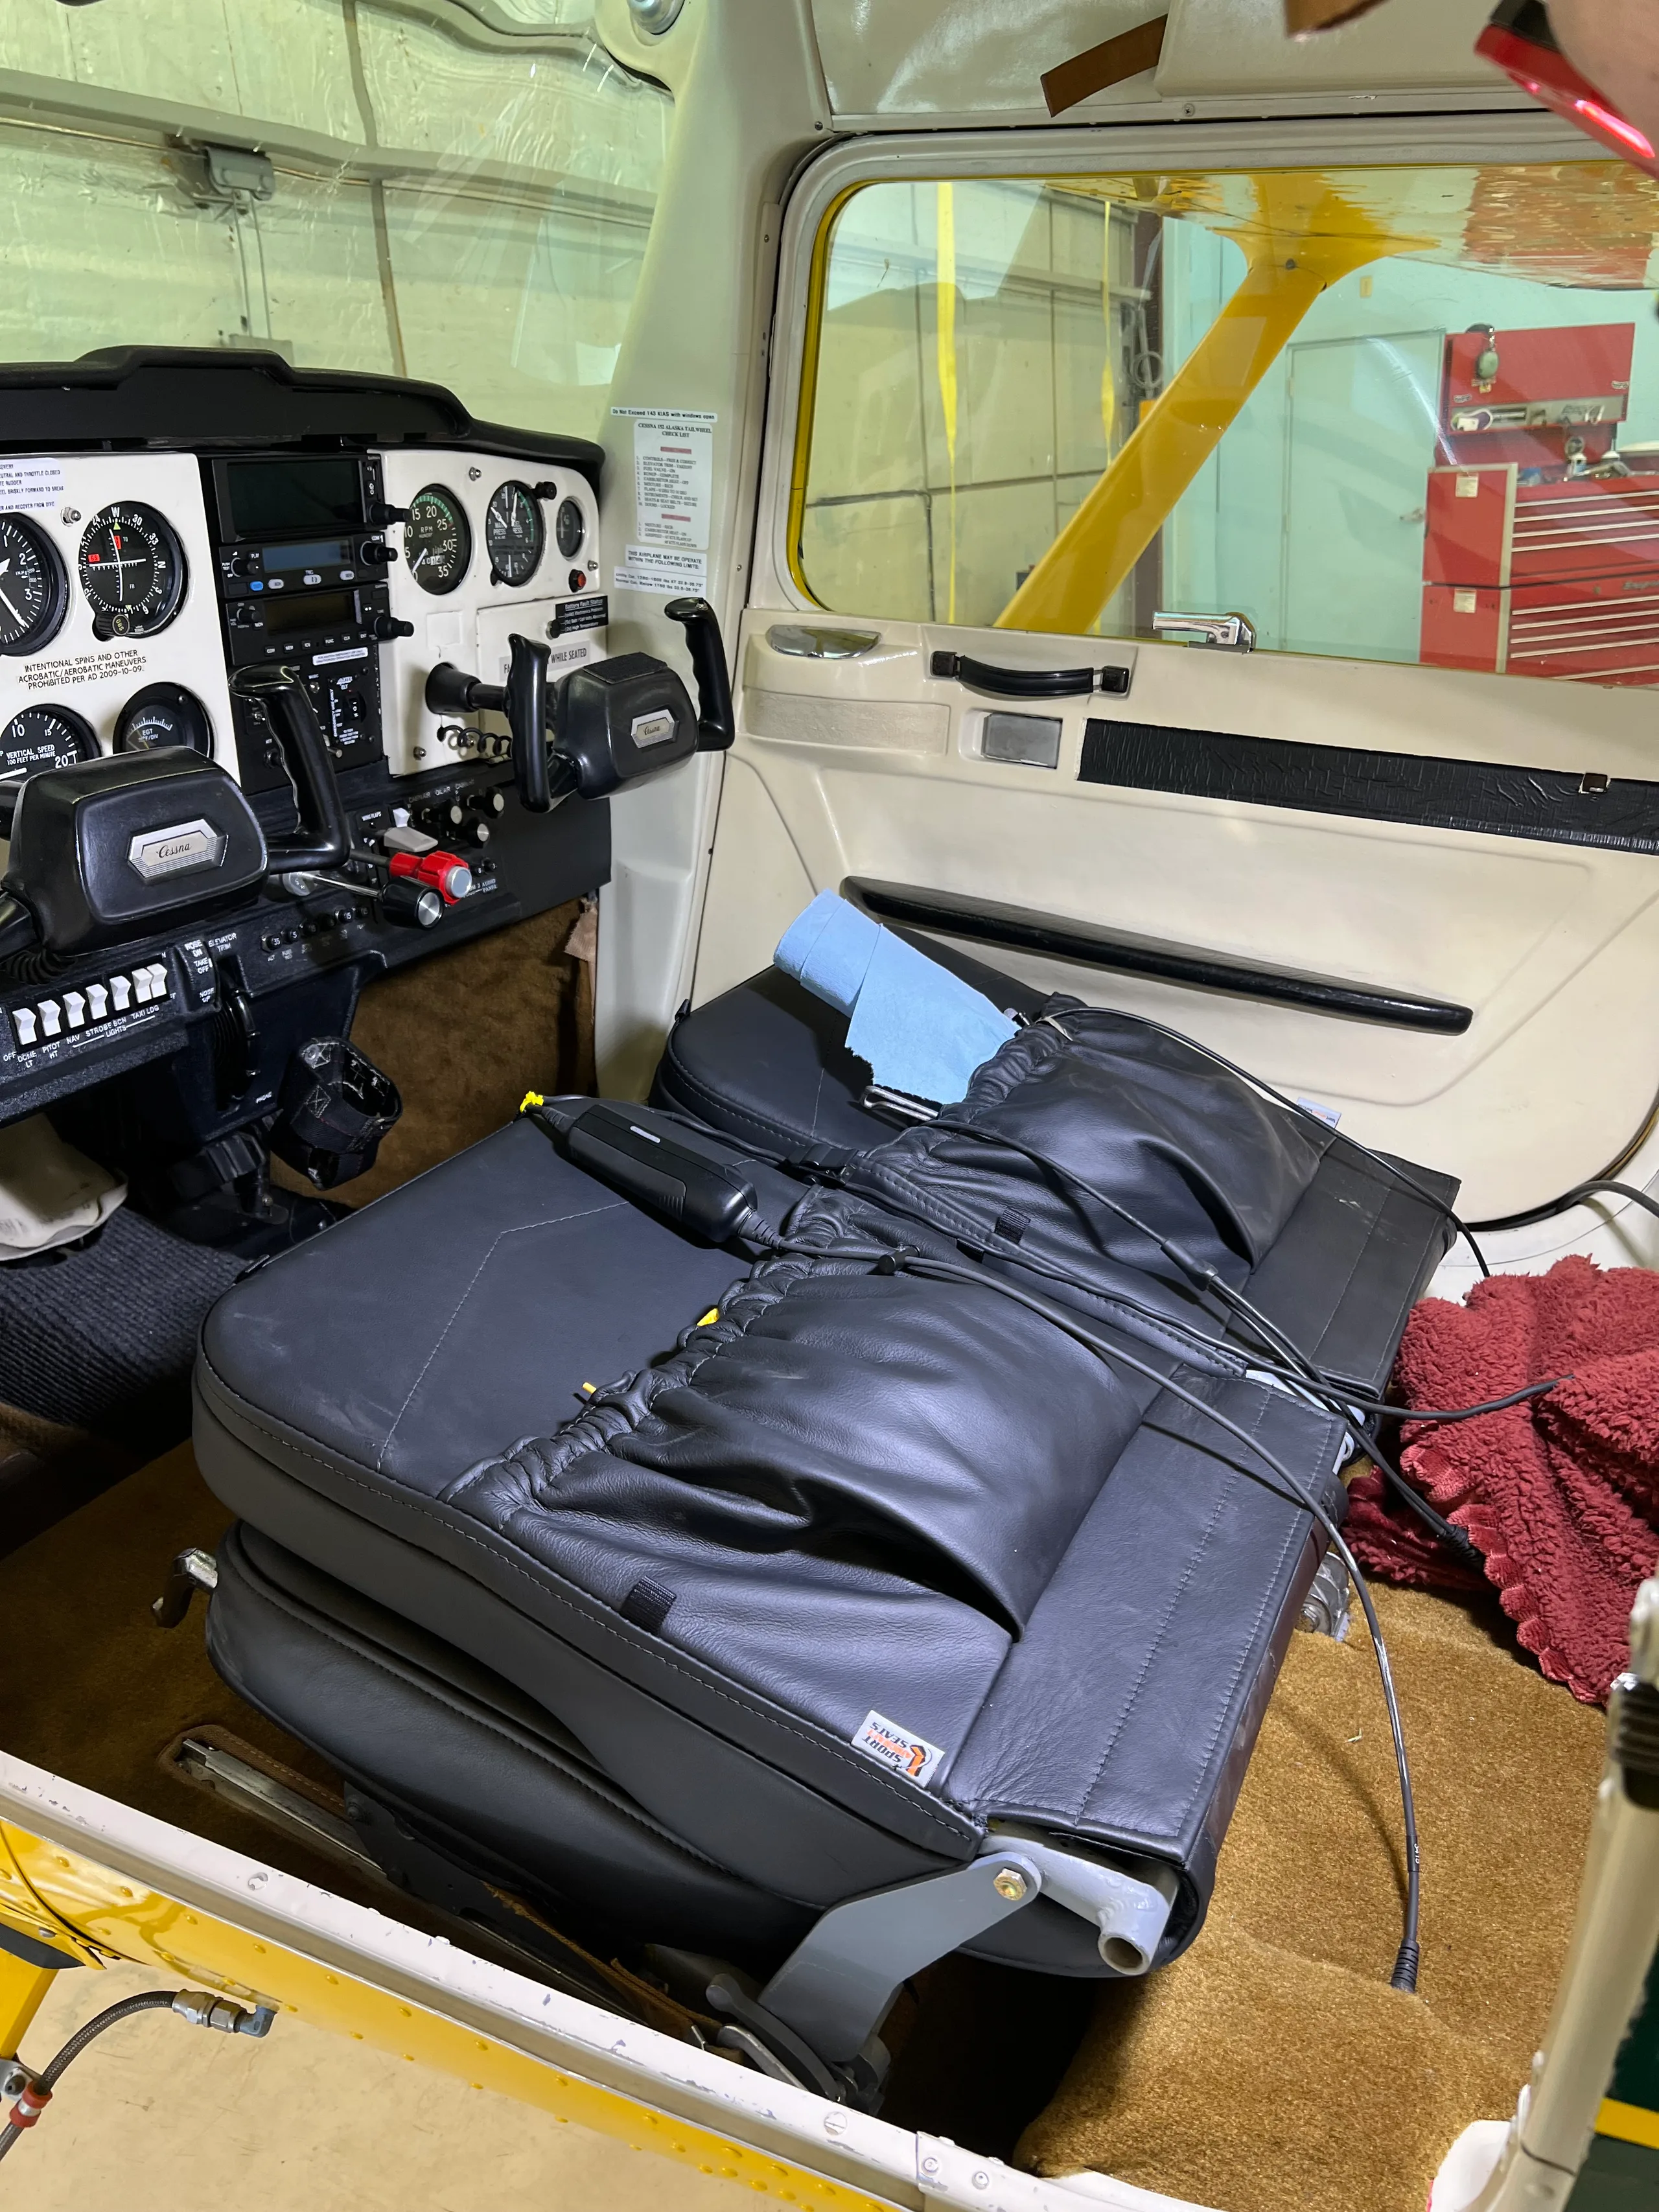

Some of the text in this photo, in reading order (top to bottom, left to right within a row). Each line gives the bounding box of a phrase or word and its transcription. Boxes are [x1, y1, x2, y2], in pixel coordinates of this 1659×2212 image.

[111, 507, 120, 517] W
[412, 508, 421, 520] 15
[426, 506, 437, 518] 20
[132, 514, 142, 526] 30
[437, 519, 447, 531] 25
[404, 526, 413, 538] 10
[149, 533, 159, 545] 33
[443, 540, 453, 551] 30
[405, 547, 410, 558] 5
[19, 553, 27, 565] 2
[655, 559, 682, 567] FOLLOWING
[438, 566, 448, 577] 35
[25, 588, 32, 600] 3
[115, 619, 124, 631] OBS
[25, 649, 137, 672] INTENTIONAL SPINS AND OTHER
[551, 648, 586, 663] WHILE SEATED
[18, 657, 146, 683] ACROBATIC/AEROBATIC MANEUVERS
[29, 677, 70, 690] PROHIBITED
[12, 724, 25, 738] 10
[6, 745, 55, 760] VERTICAL SPEED
[40, 751, 56, 760] MINUTE
[55, 755, 68, 769] 20
[156, 843, 192, 858] Cessna
[483, 884, 498, 893] PANEL
[185, 940, 202, 950] NOSE
[209, 933, 237, 947] ELEVATOR
[217, 943, 231, 952] TRIM
[194, 957, 208, 967] TAKE
[198, 965, 209, 974] OFF
[200, 987, 215, 998] NOSE
[66, 1005, 159, 1044] NAV STROBE BCN TAXI LDG
[106, 1025, 127, 1038] LIGHTS
[42, 1042, 60, 1053] PITOT
[3, 1051, 17, 1061] OFF
[17, 1051, 37, 1062] DOME
[49, 1051, 58, 1059] HT
[25, 1060, 33, 1068] LT
[870, 1722, 909, 1749] SEATS
[862, 1736, 903, 1763] SPORT
